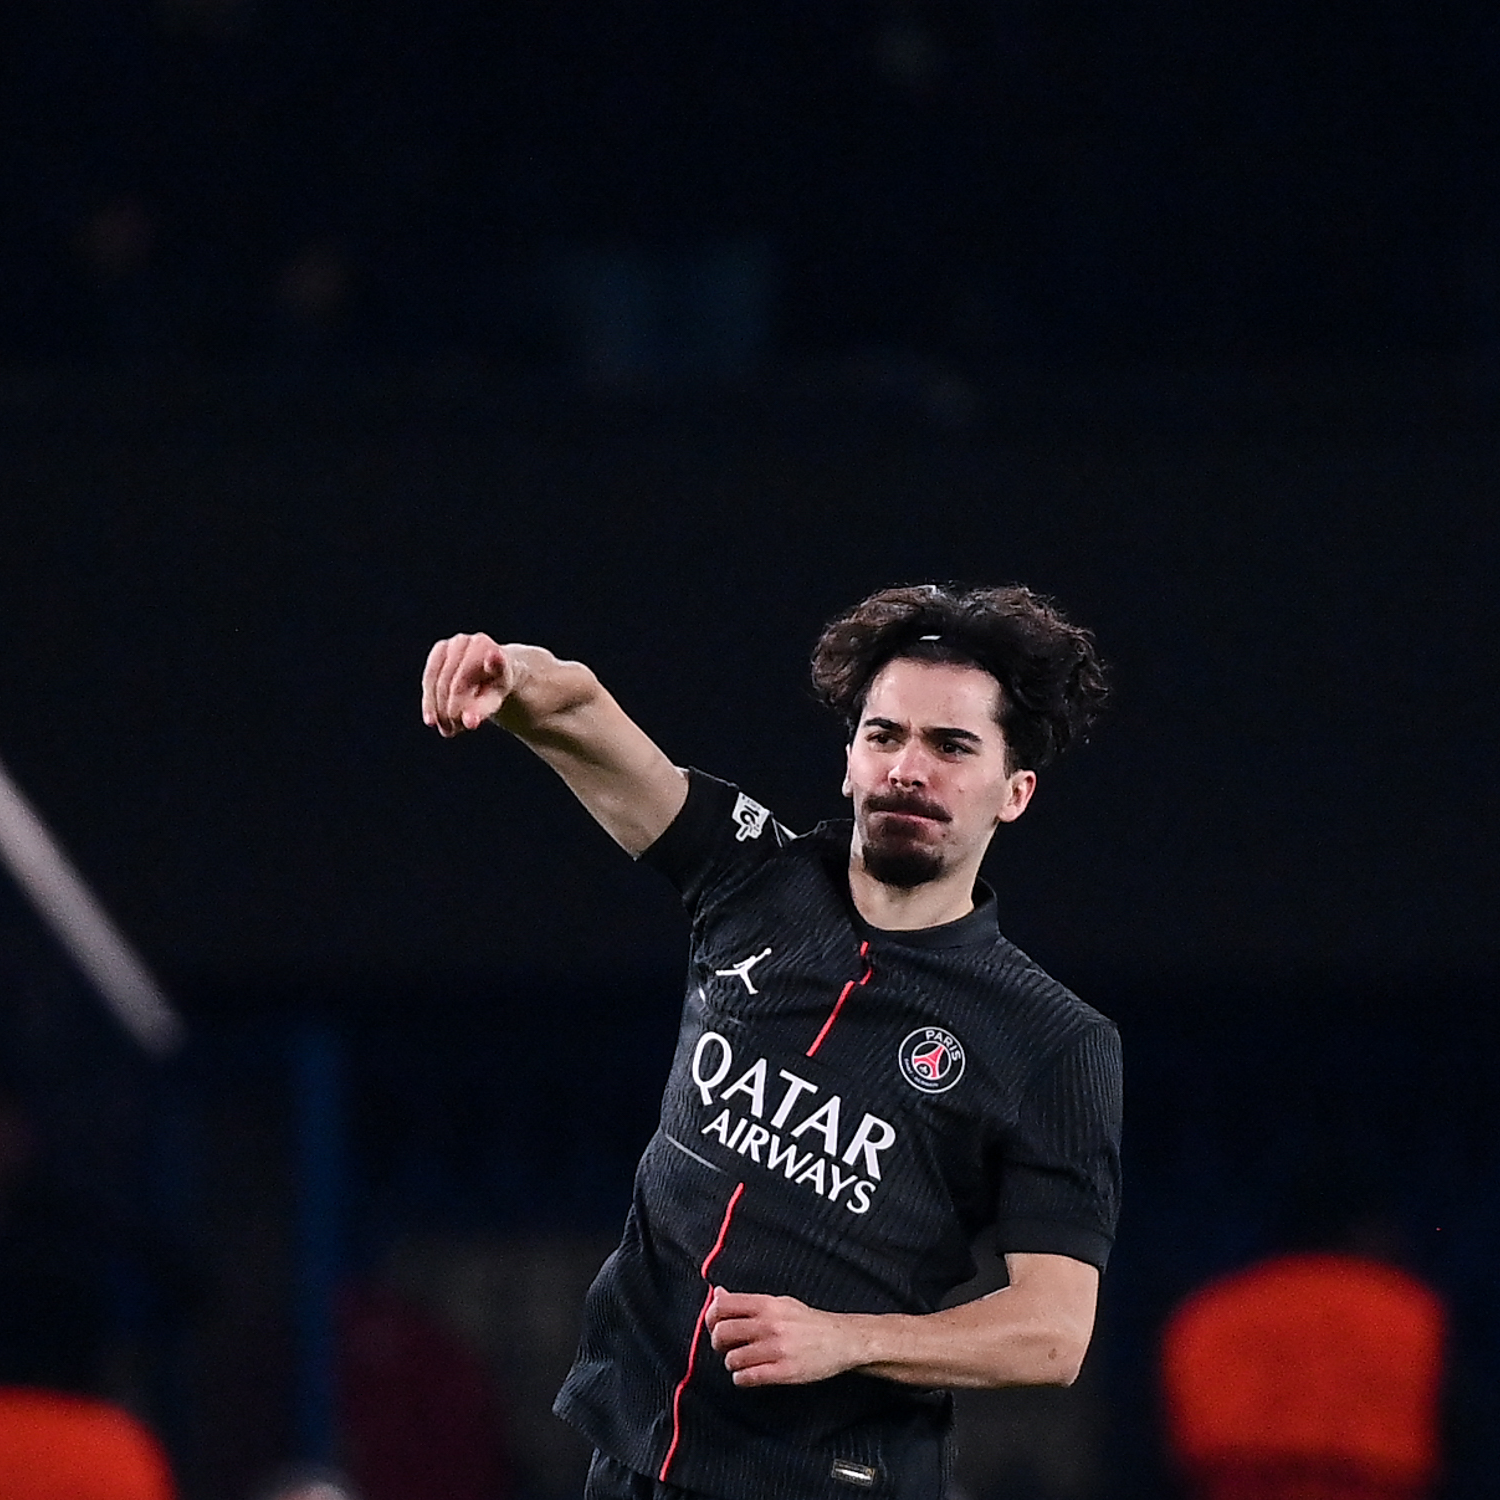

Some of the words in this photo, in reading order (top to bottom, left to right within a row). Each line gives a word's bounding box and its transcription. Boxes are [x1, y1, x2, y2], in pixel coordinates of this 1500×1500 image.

[925, 1029, 961, 1061] PARIS
[691, 1031, 897, 1182] QATAR
[701, 1109, 877, 1215] AIRWAYS
